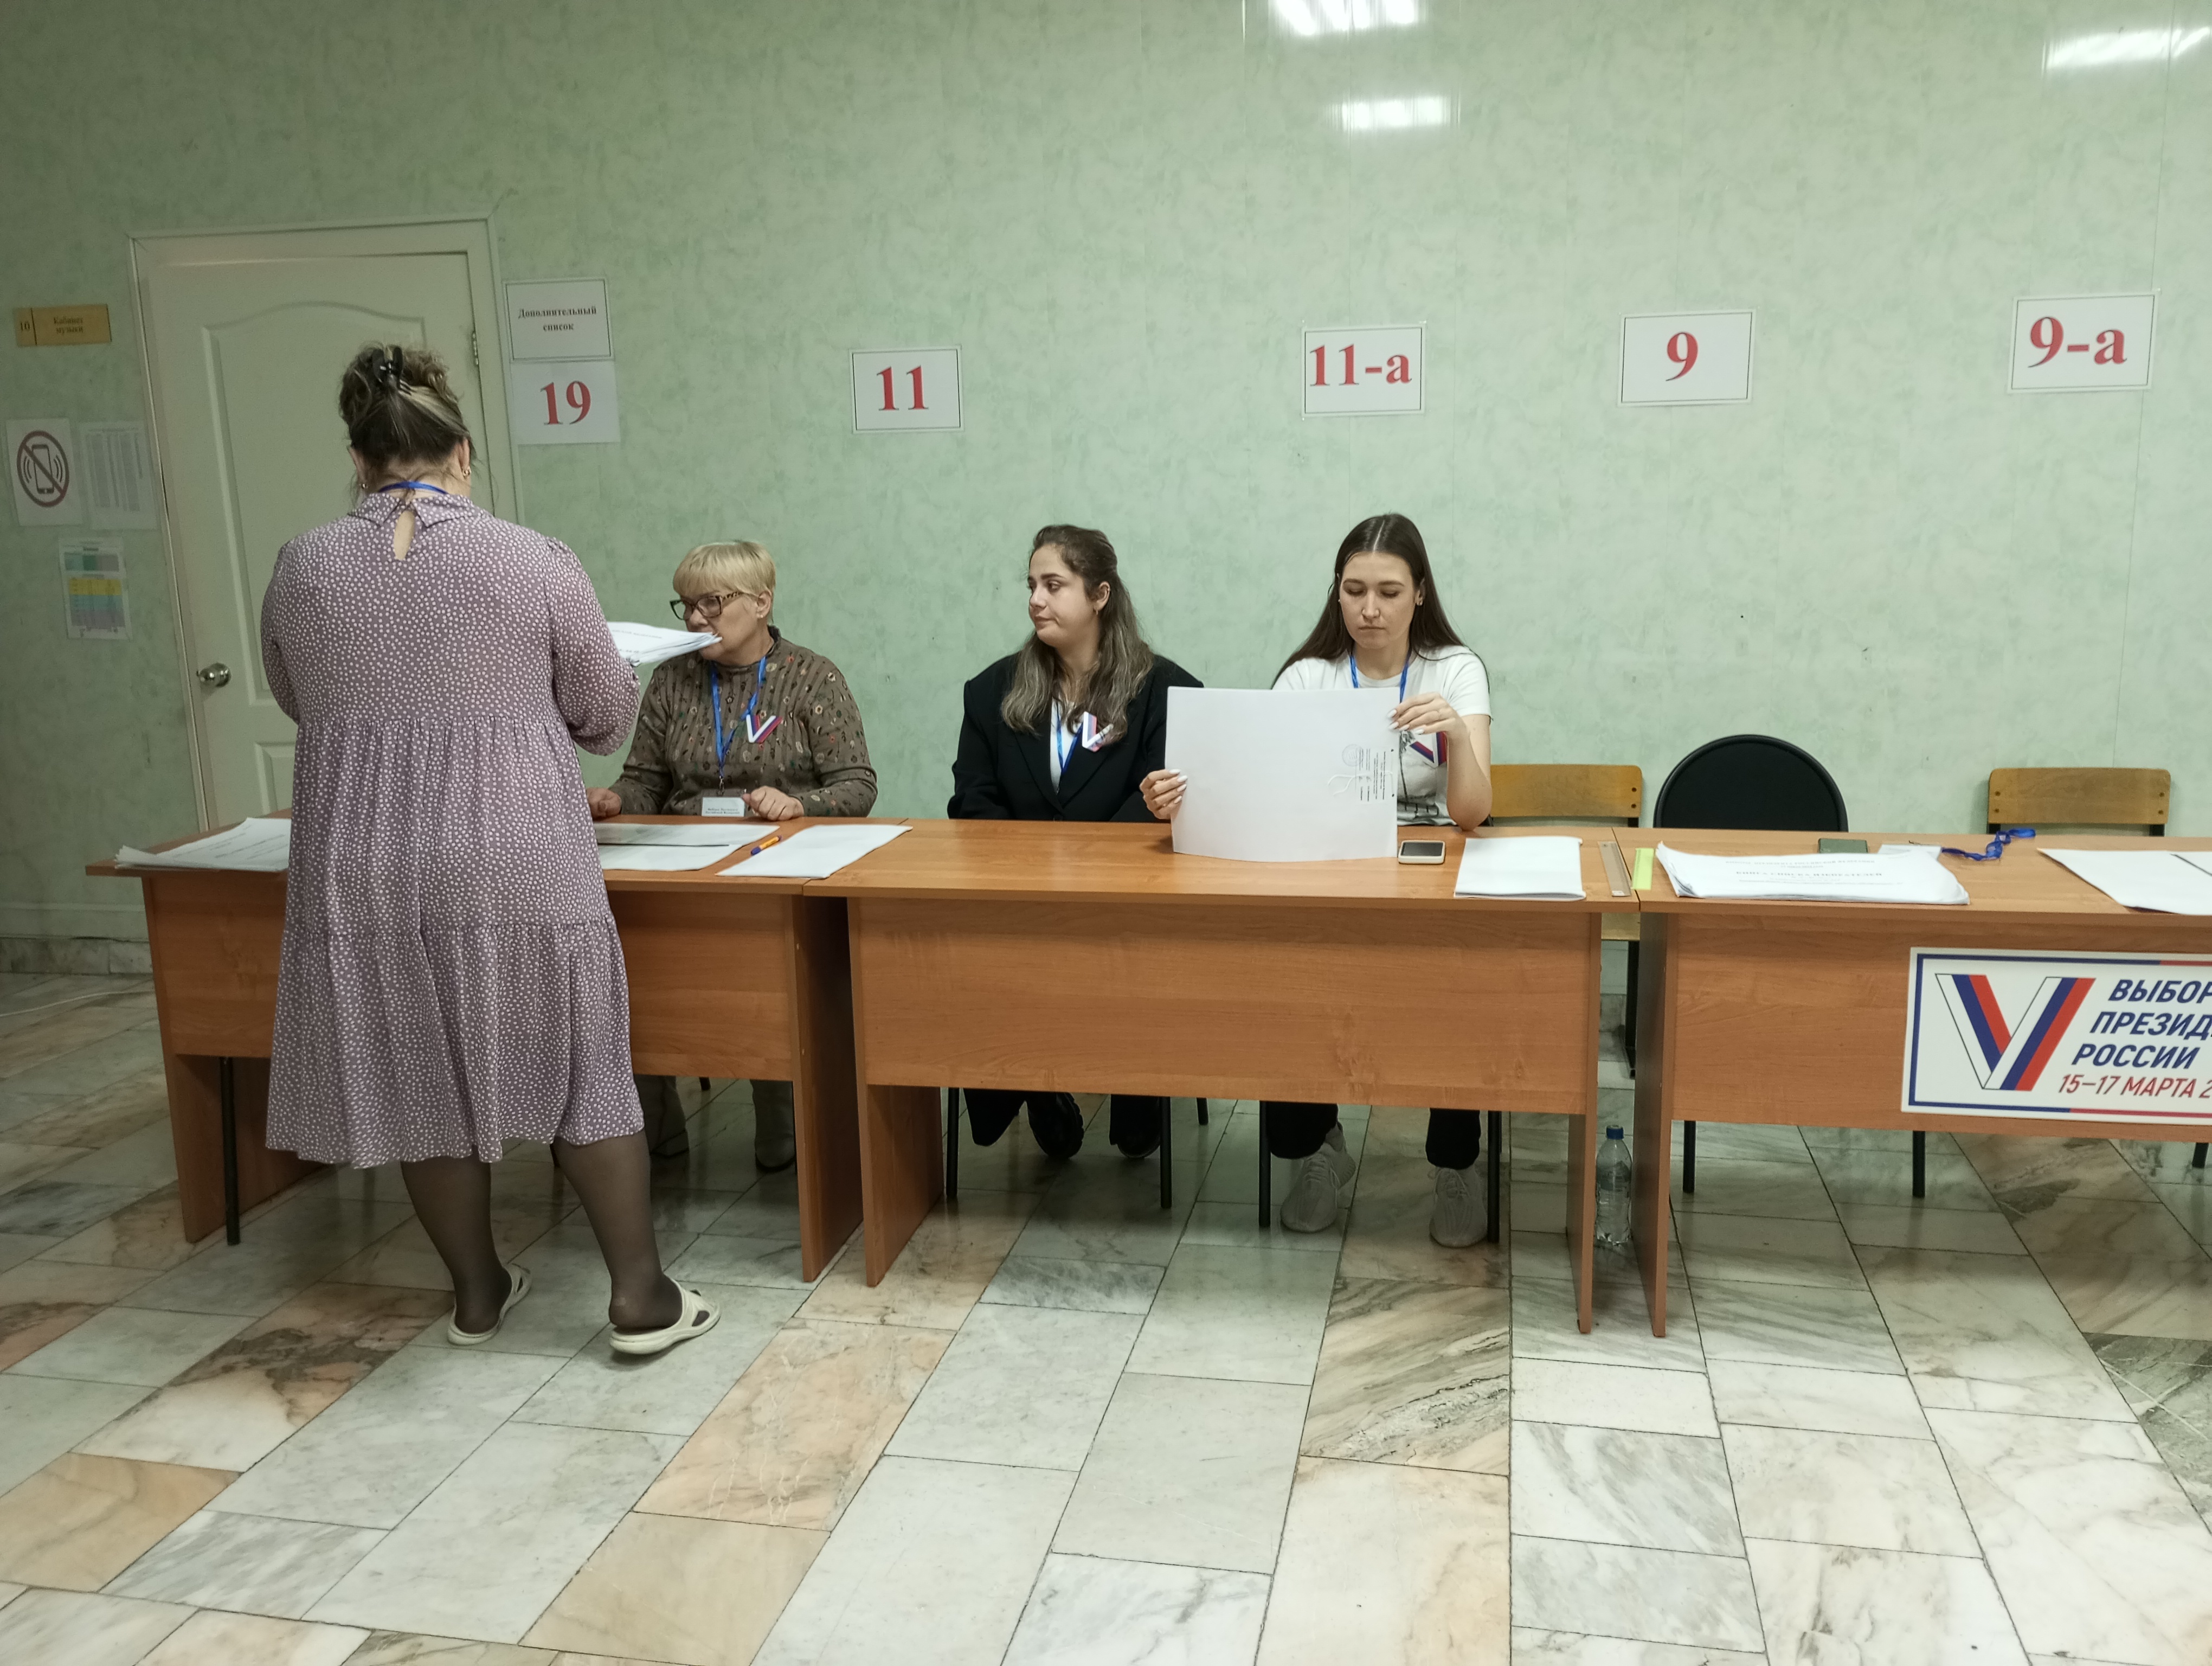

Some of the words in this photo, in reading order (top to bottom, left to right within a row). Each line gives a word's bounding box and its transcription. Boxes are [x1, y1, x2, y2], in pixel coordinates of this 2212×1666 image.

[518, 305, 596, 319] Дополнительный
[543, 324, 574, 332] список
[1665, 331, 1699, 382] 9
[2027, 316, 2127, 368] 9-а
[1309, 343, 1412, 387] 11-а
[540, 380, 591, 425] 19
[876, 365, 929, 411] 11
[2089, 1011, 2212, 1040] ПРЕЗИД
[2071, 1043, 2200, 1069] РОССИИ
[2120, 1077, 2197, 1098] МАРТА
